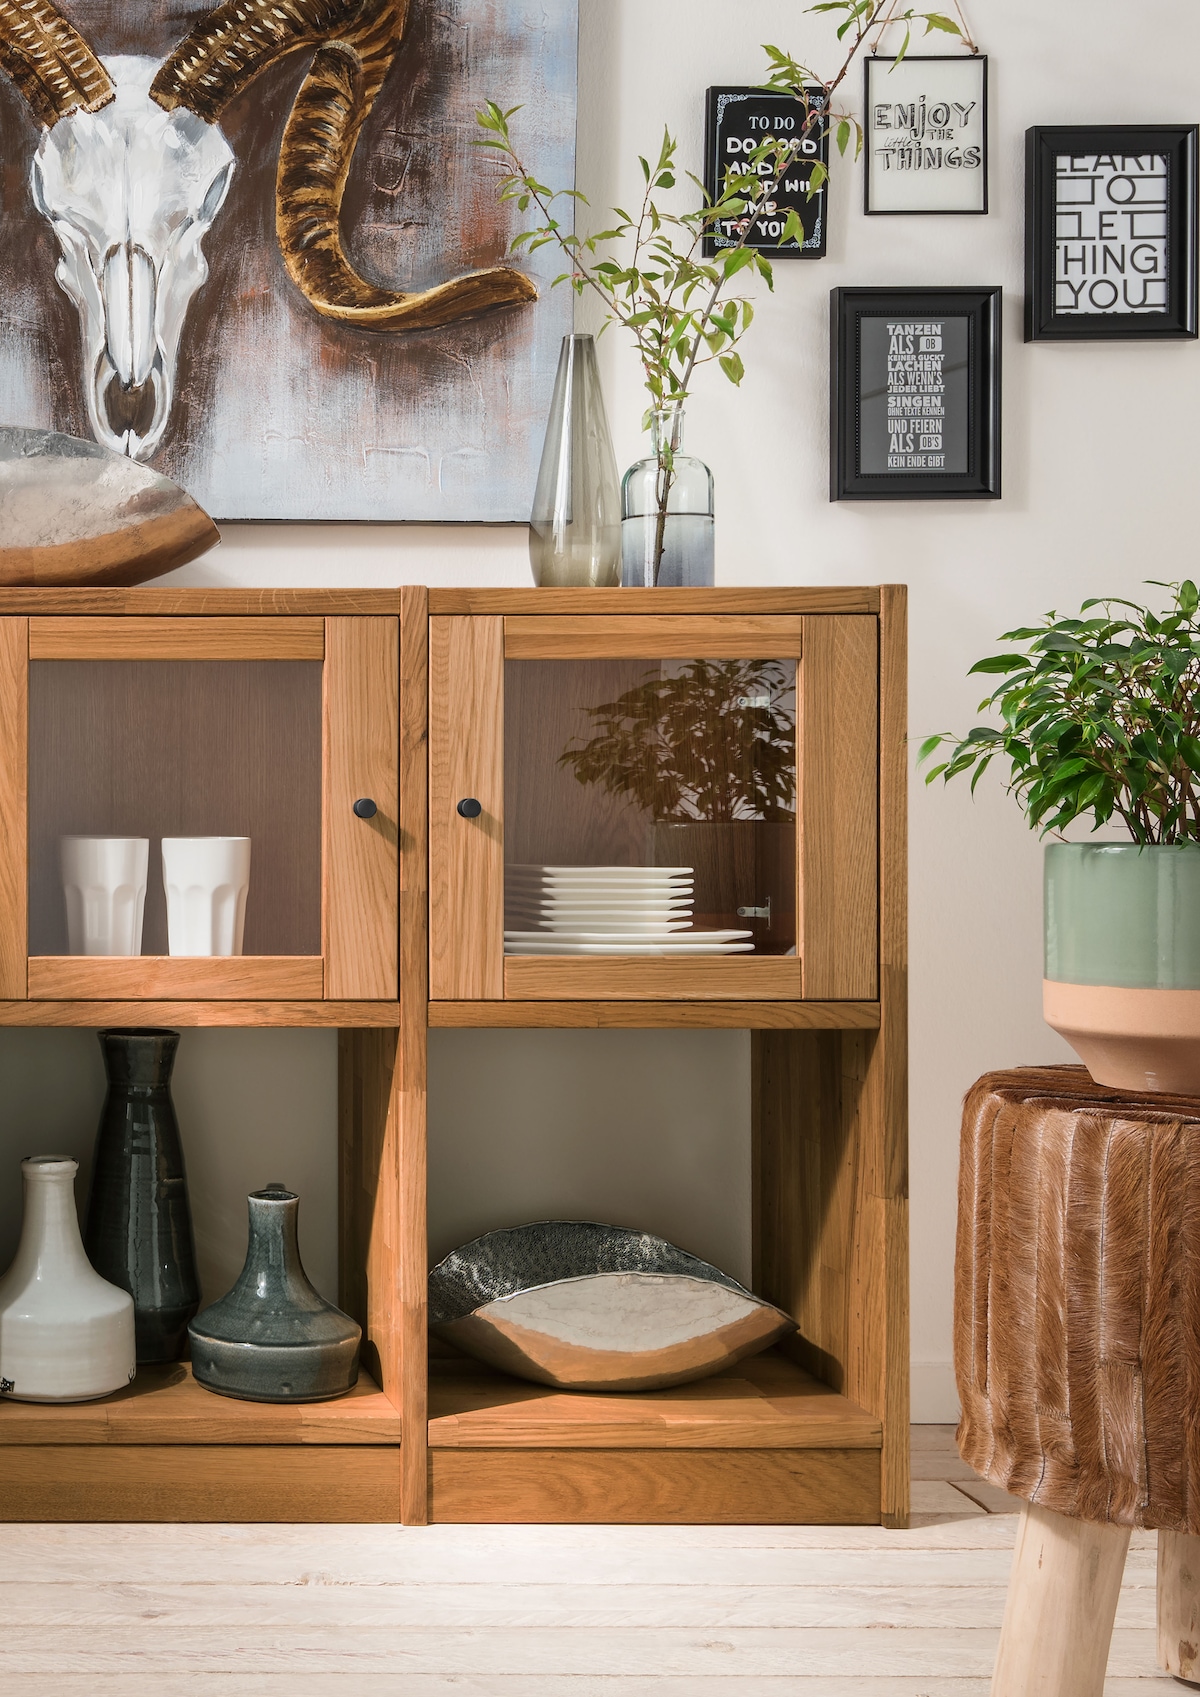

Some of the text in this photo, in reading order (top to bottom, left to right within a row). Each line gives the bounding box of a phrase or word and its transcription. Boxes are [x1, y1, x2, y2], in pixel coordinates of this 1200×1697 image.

[749, 116, 795, 130] TO DO
[926, 129, 954, 140] THE
[726, 137, 757, 154] DO
[729, 160, 773, 175] AND
[723, 180, 778, 193] OD
[1066, 174, 1141, 205] TO
[1056, 244, 1166, 275] HING
[1060, 279, 1153, 309] YOU
[887, 324, 941, 336] TANZEN
[889, 335, 936, 354] ALS OB
[888, 361, 942, 372] LACHEN
[888, 372, 942, 385] ALS WENN'S
[887, 385, 917, 393] JEDER
[888, 396, 942, 407] SINGEN
[888, 407, 944, 416] OHNE TEXTE KENNEN
[888, 419, 942, 434] UND FEIERN
[890, 434, 939, 453] ALS OB'S
[888, 456, 945, 467] KEIN ENDE GIBT
